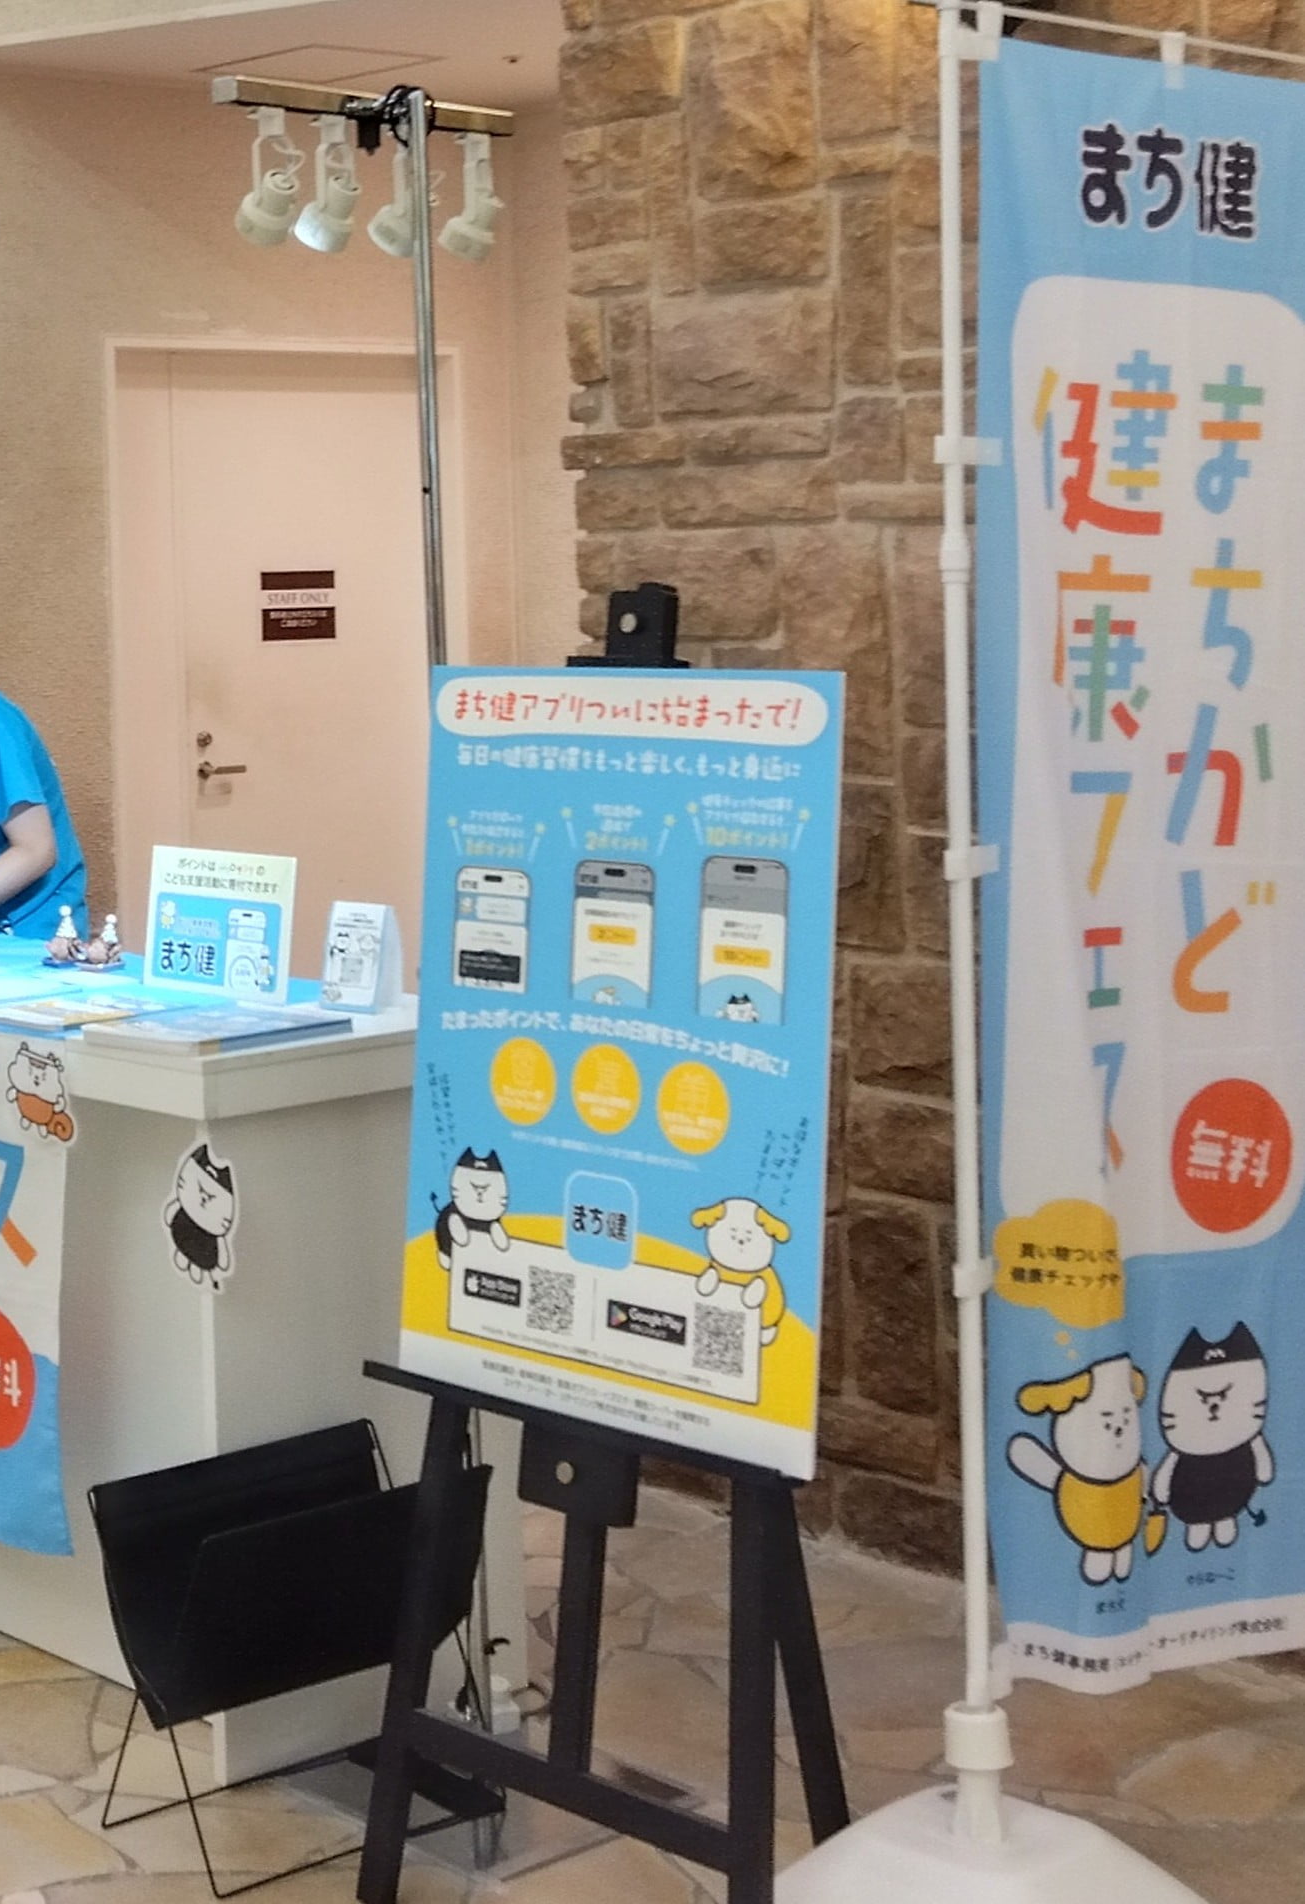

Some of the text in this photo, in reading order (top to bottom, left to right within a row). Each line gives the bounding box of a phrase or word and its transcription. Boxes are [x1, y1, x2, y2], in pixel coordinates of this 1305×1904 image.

[1080, 123, 1257, 239] まち健
[267, 592, 329, 605] STAFF ONLY
[453, 688, 804, 730] まち健アプリついに始まったで!
[1163, 363, 1277, 1013] まちかど
[1031, 349, 1179, 1185] 健康フェス
[159, 940, 217, 978] まち健
[1185, 1119, 1273, 1189] 無料
[570, 1203, 629, 1243] まち健
